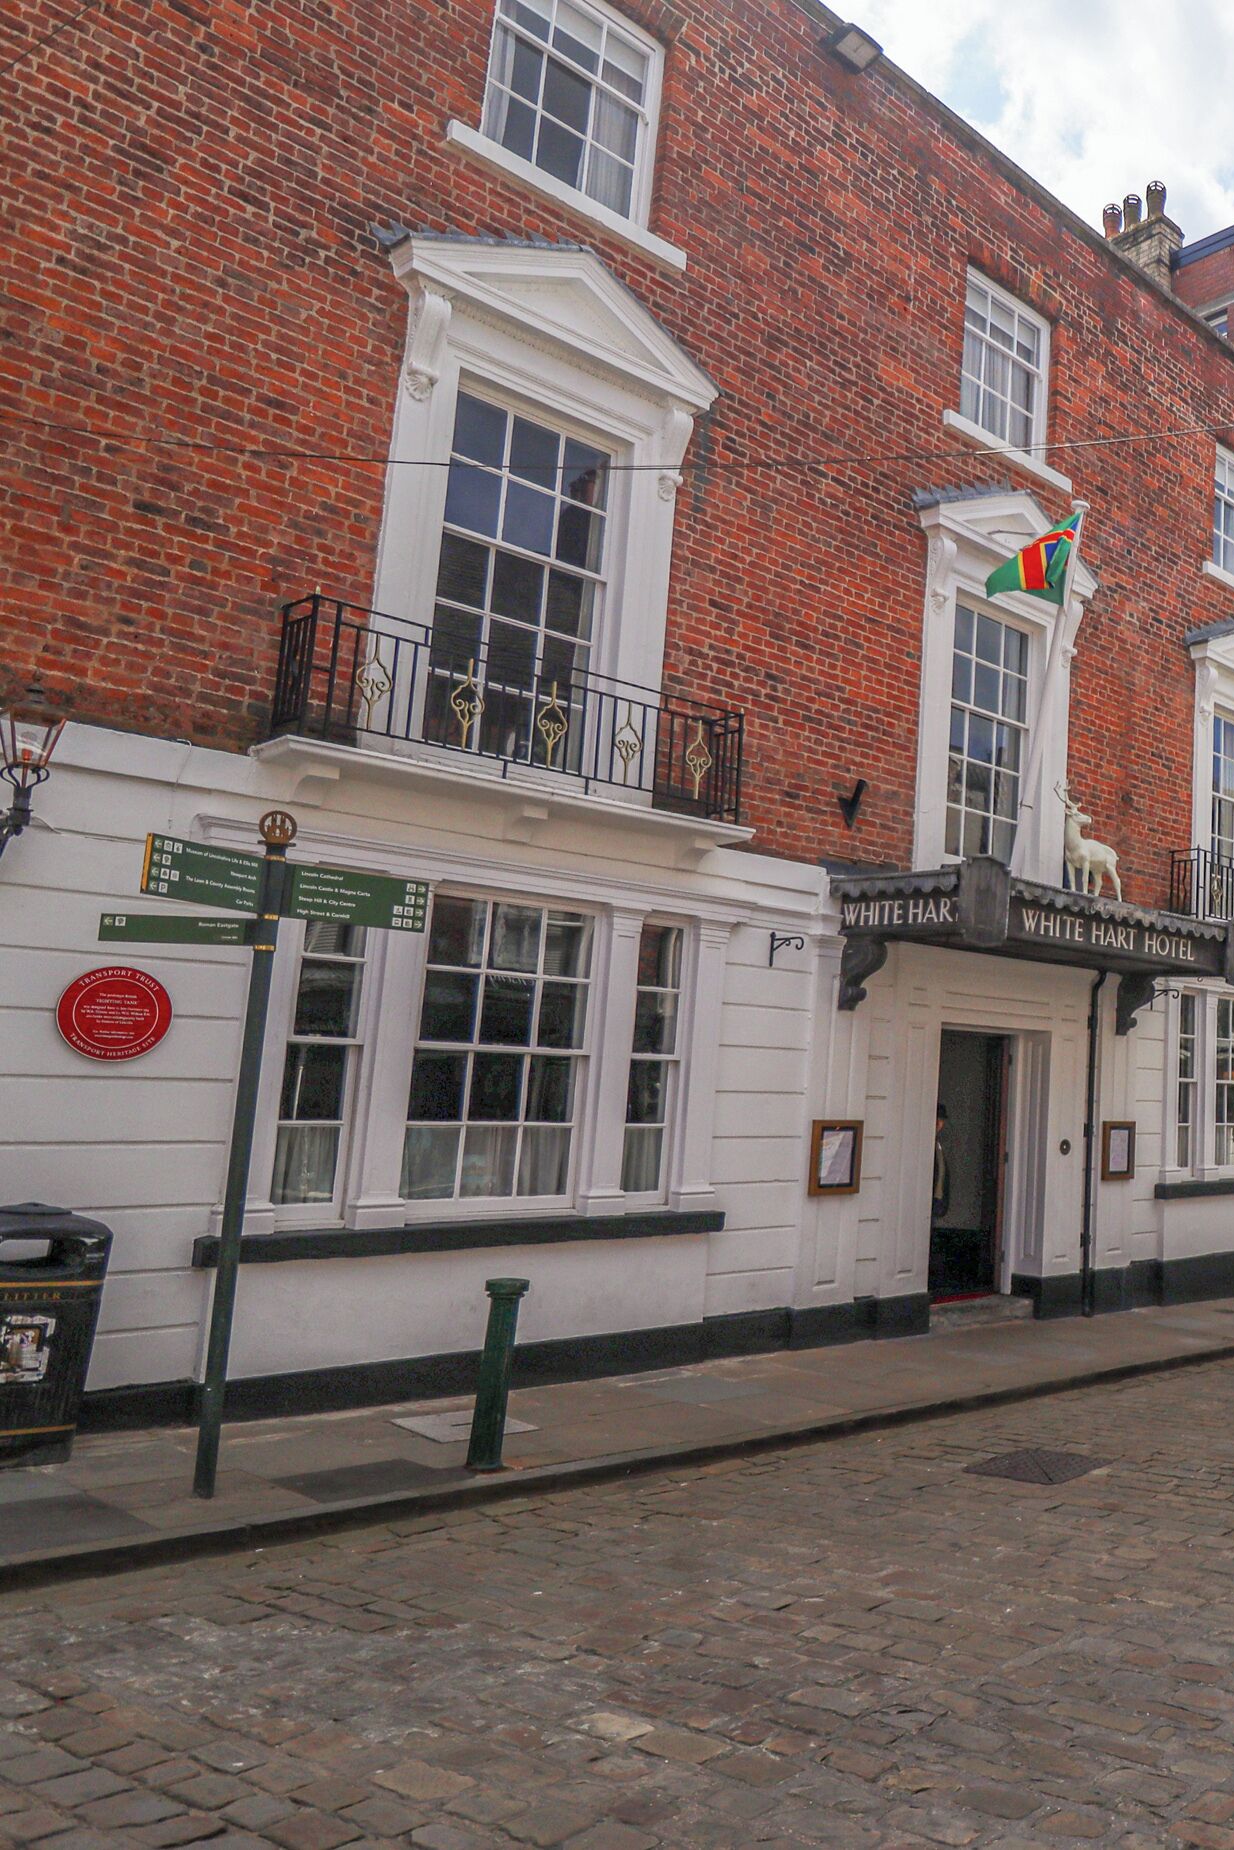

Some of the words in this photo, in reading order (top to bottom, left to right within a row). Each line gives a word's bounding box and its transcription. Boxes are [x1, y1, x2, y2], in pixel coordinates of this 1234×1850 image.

[844, 900, 903, 926] WHITE
[1022, 908, 1083, 942] WHITE
[1092, 922, 1137, 951] HART
[1144, 931, 1195, 961] HOTEL
[80, 969, 132, 987] TRANSPORT
[136, 974, 160, 992] TRUST
[70, 1033, 105, 1056] TRANSPORT
[107, 1047, 140, 1057] HERITAGE
[142, 1036, 156, 1048] SITE
